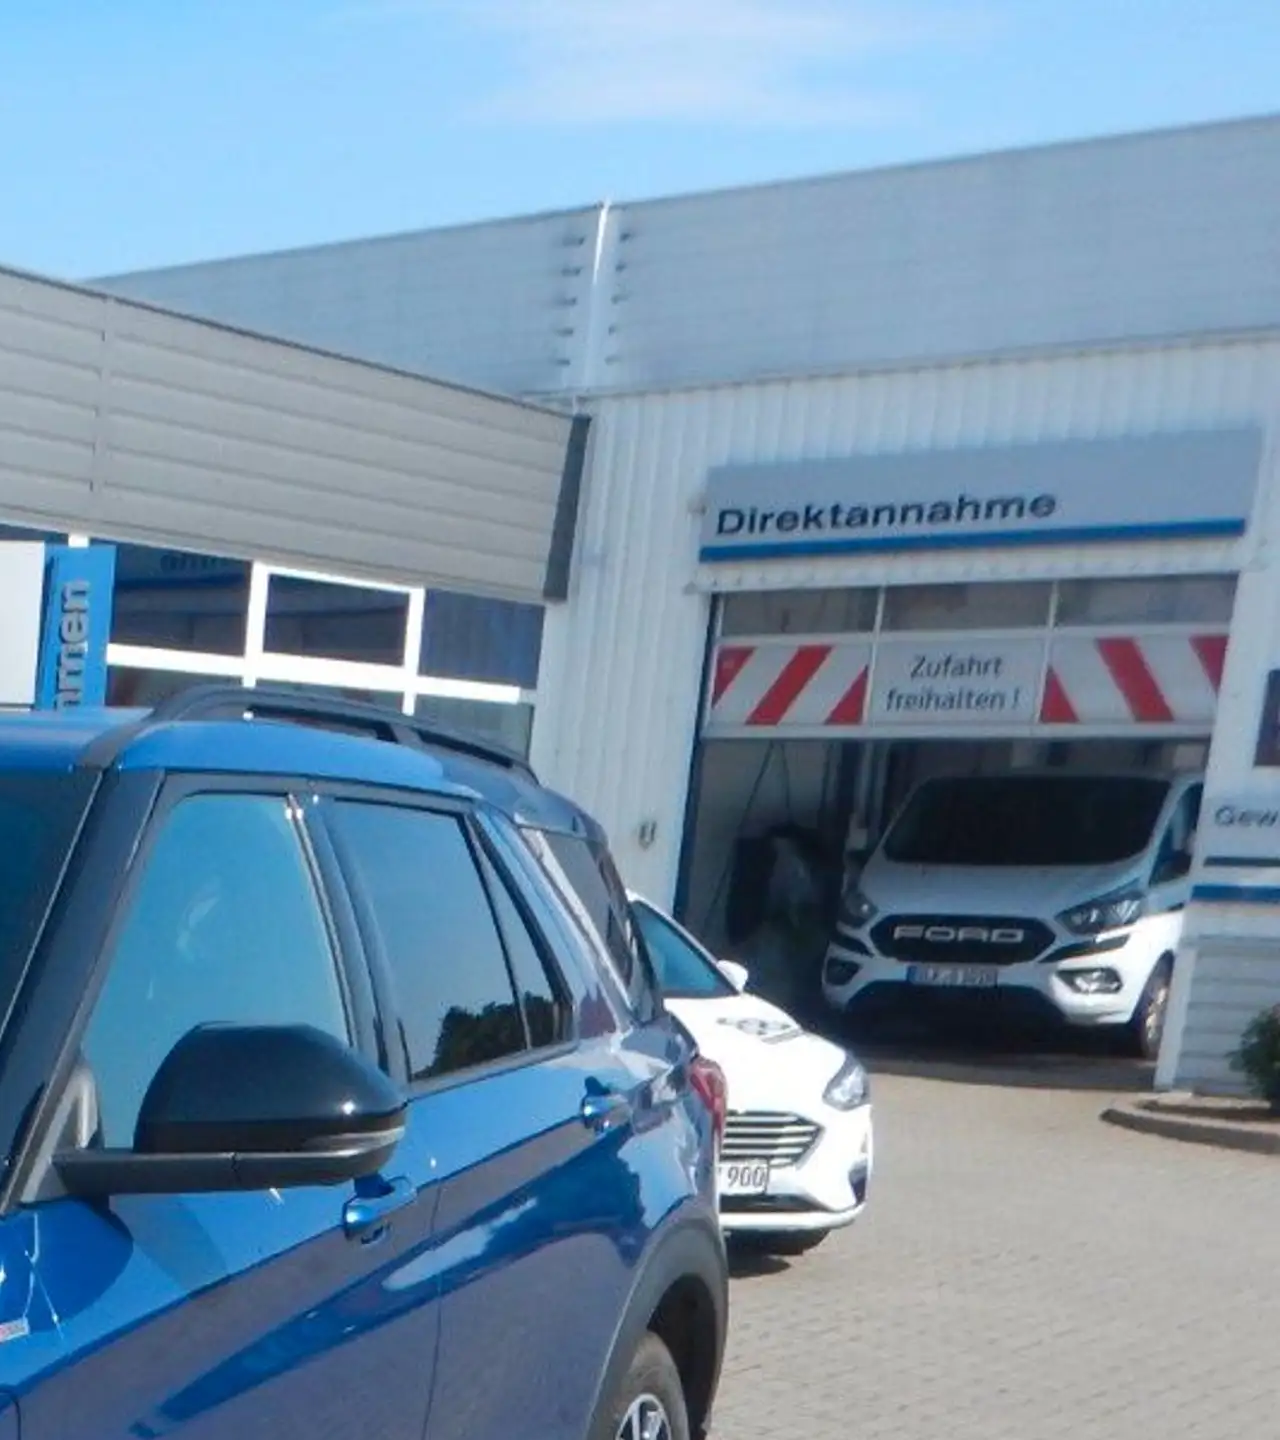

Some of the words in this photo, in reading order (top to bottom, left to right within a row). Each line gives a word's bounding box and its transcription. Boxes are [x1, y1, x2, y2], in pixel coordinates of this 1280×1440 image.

[716, 494, 1057, 536] Direktannahme
[910, 653, 1003, 681] Zufahrt
[892, 924, 1025, 944] FORD
